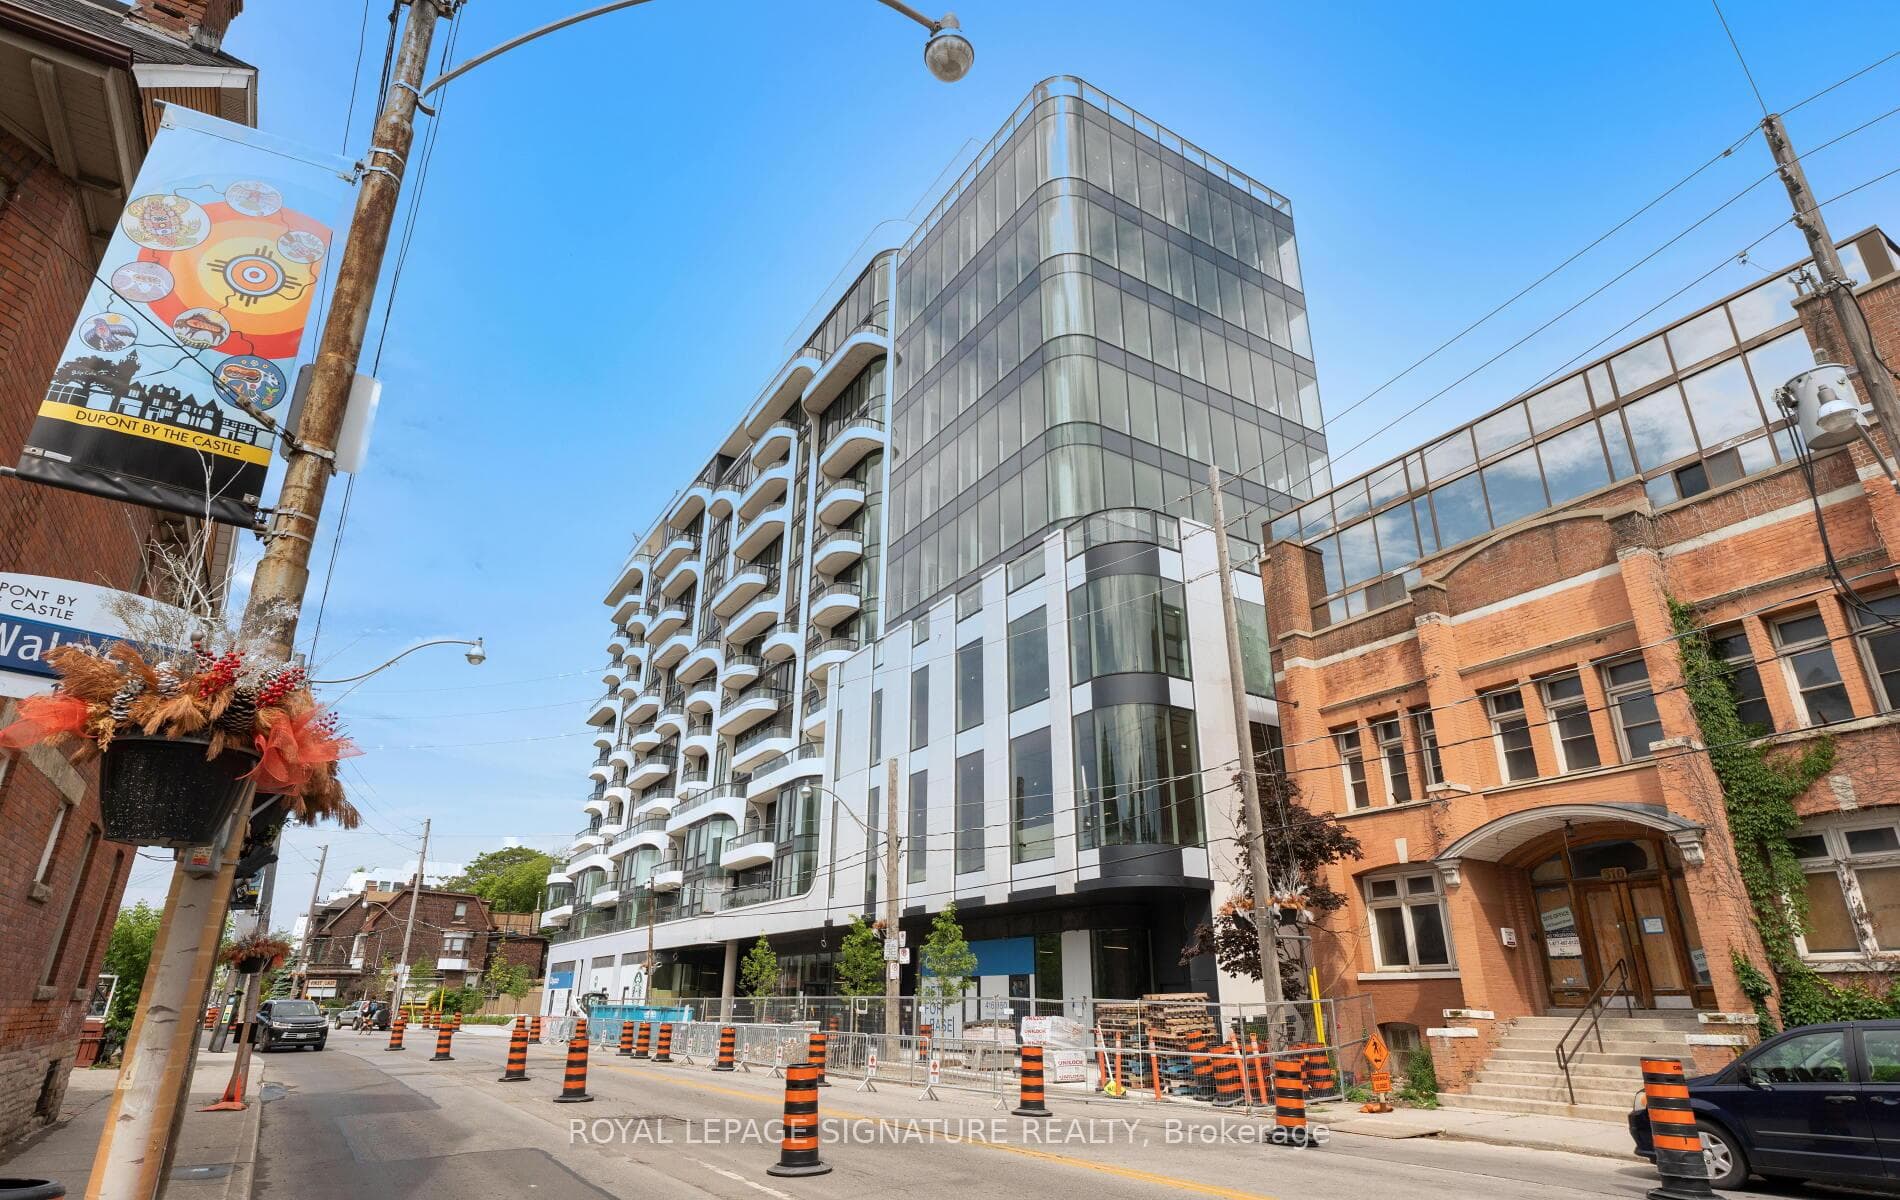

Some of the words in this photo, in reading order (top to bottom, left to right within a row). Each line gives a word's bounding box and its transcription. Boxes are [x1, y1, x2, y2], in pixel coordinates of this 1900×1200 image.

[75, 410, 139, 431] DUPONT
[142, 423, 160, 435] BY
[163, 428, 189, 443] THE
[192, 435, 242, 456] CASTLE
[10, 599, 74, 621] CASTLE
[56, 594, 78, 607] BY
